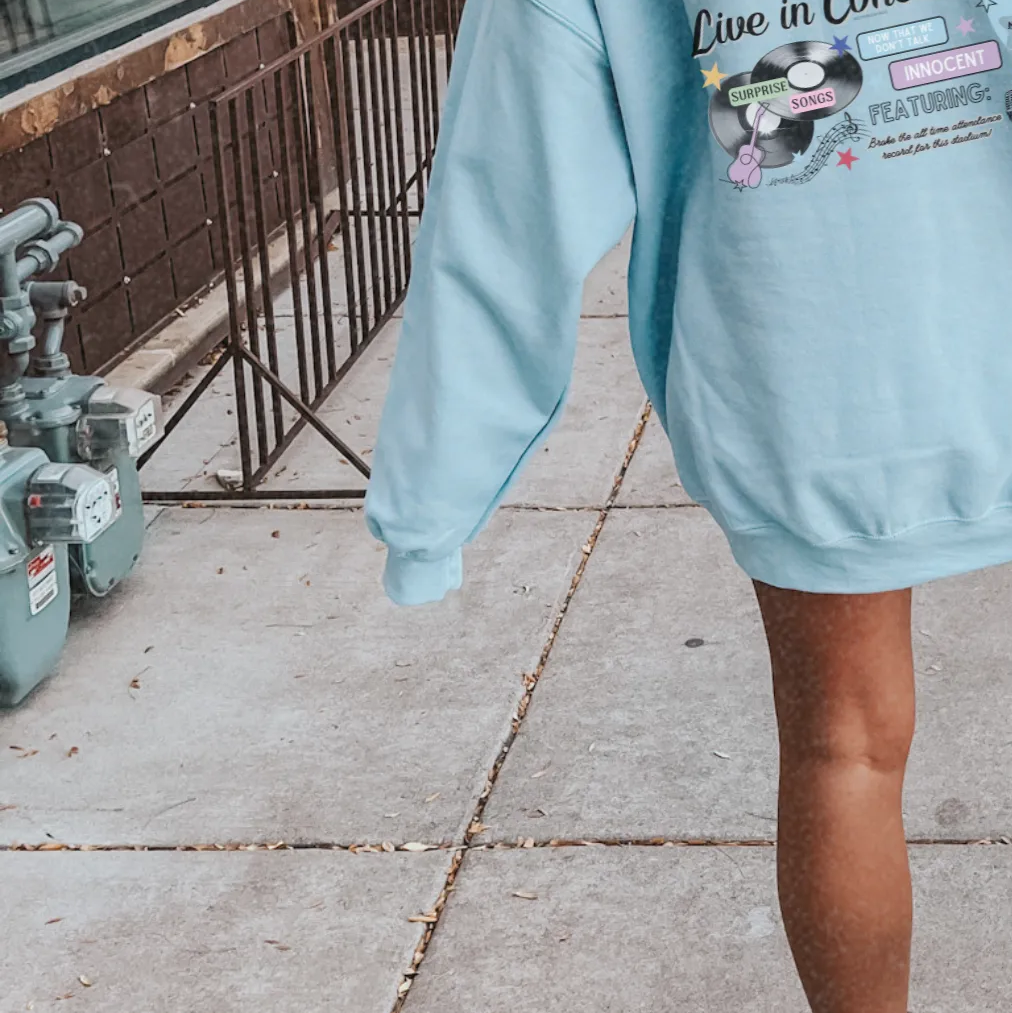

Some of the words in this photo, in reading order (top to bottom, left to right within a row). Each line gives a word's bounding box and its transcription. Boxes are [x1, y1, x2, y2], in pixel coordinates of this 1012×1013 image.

[691, 8, 770, 57] Live
[867, 32, 890, 45] NOW
[892, 26, 915, 38] THAT
[918, 22, 933, 33] WE
[875, 39, 903, 54] DON'T
[908, 34, 929, 46] TALK
[903, 49, 985, 81] INNOCENT
[730, 80, 788, 103] SURPRISE
[791, 90, 834, 110] SONGS
[868, 82, 992, 126] FEATURING:
[898, 131, 912, 142] the
[914, 127, 929, 138] all
[930, 125, 950, 136] time
[951, 114, 1003, 131] attendance
[882, 144, 914, 160] record
[913, 142, 931, 156] for
[933, 138, 949, 149] this
[950, 128, 993, 145] stadium!
